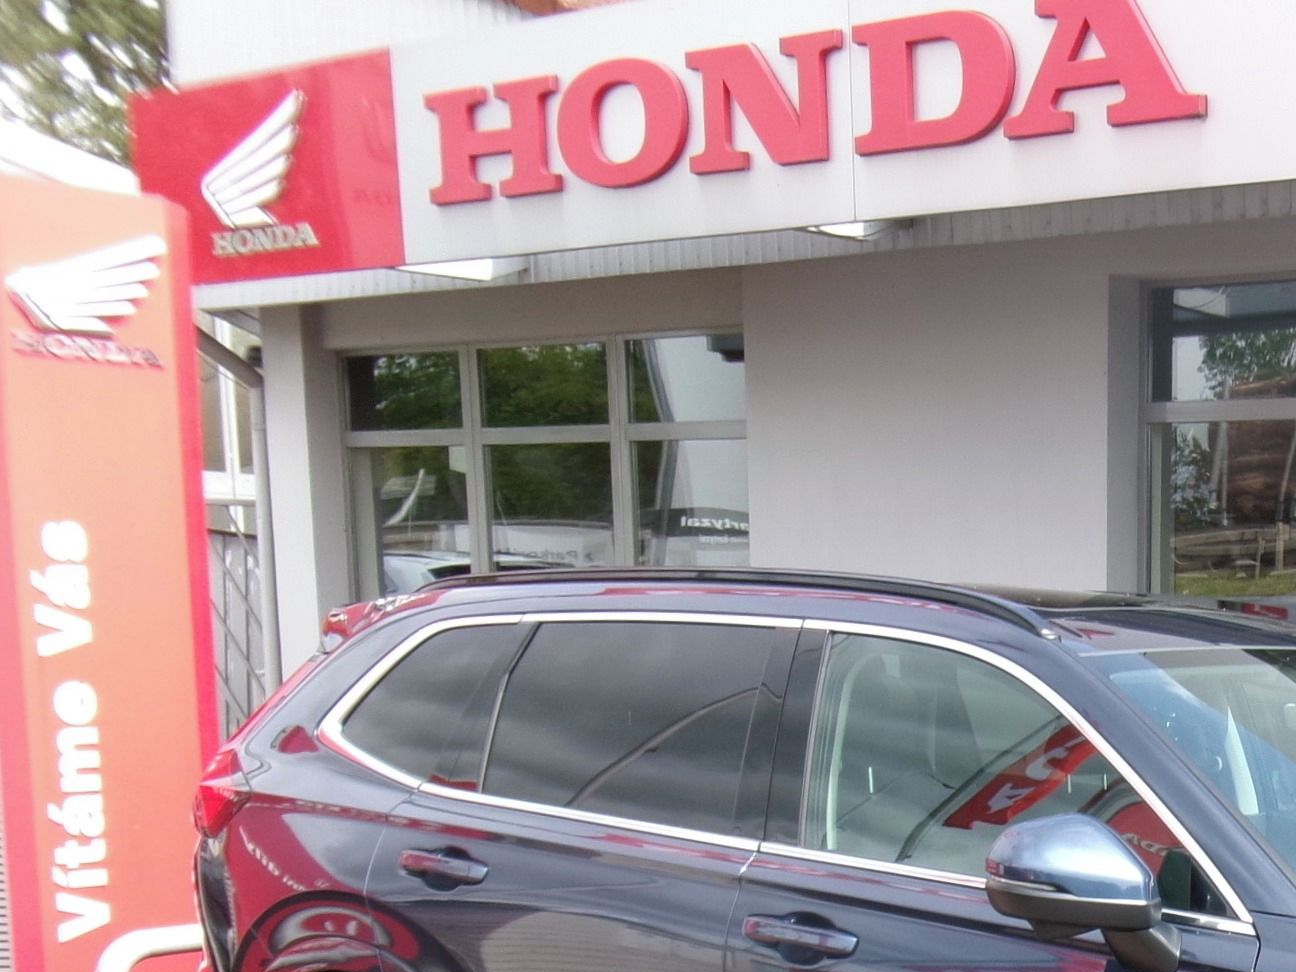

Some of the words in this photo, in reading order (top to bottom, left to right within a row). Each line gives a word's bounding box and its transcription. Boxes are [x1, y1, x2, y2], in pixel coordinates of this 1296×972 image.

[424, 0, 1208, 206] HONDA
[210, 221, 320, 257] HONDA
[30, 519, 94, 658] Vás
[46, 680, 112, 943] Vítáme
